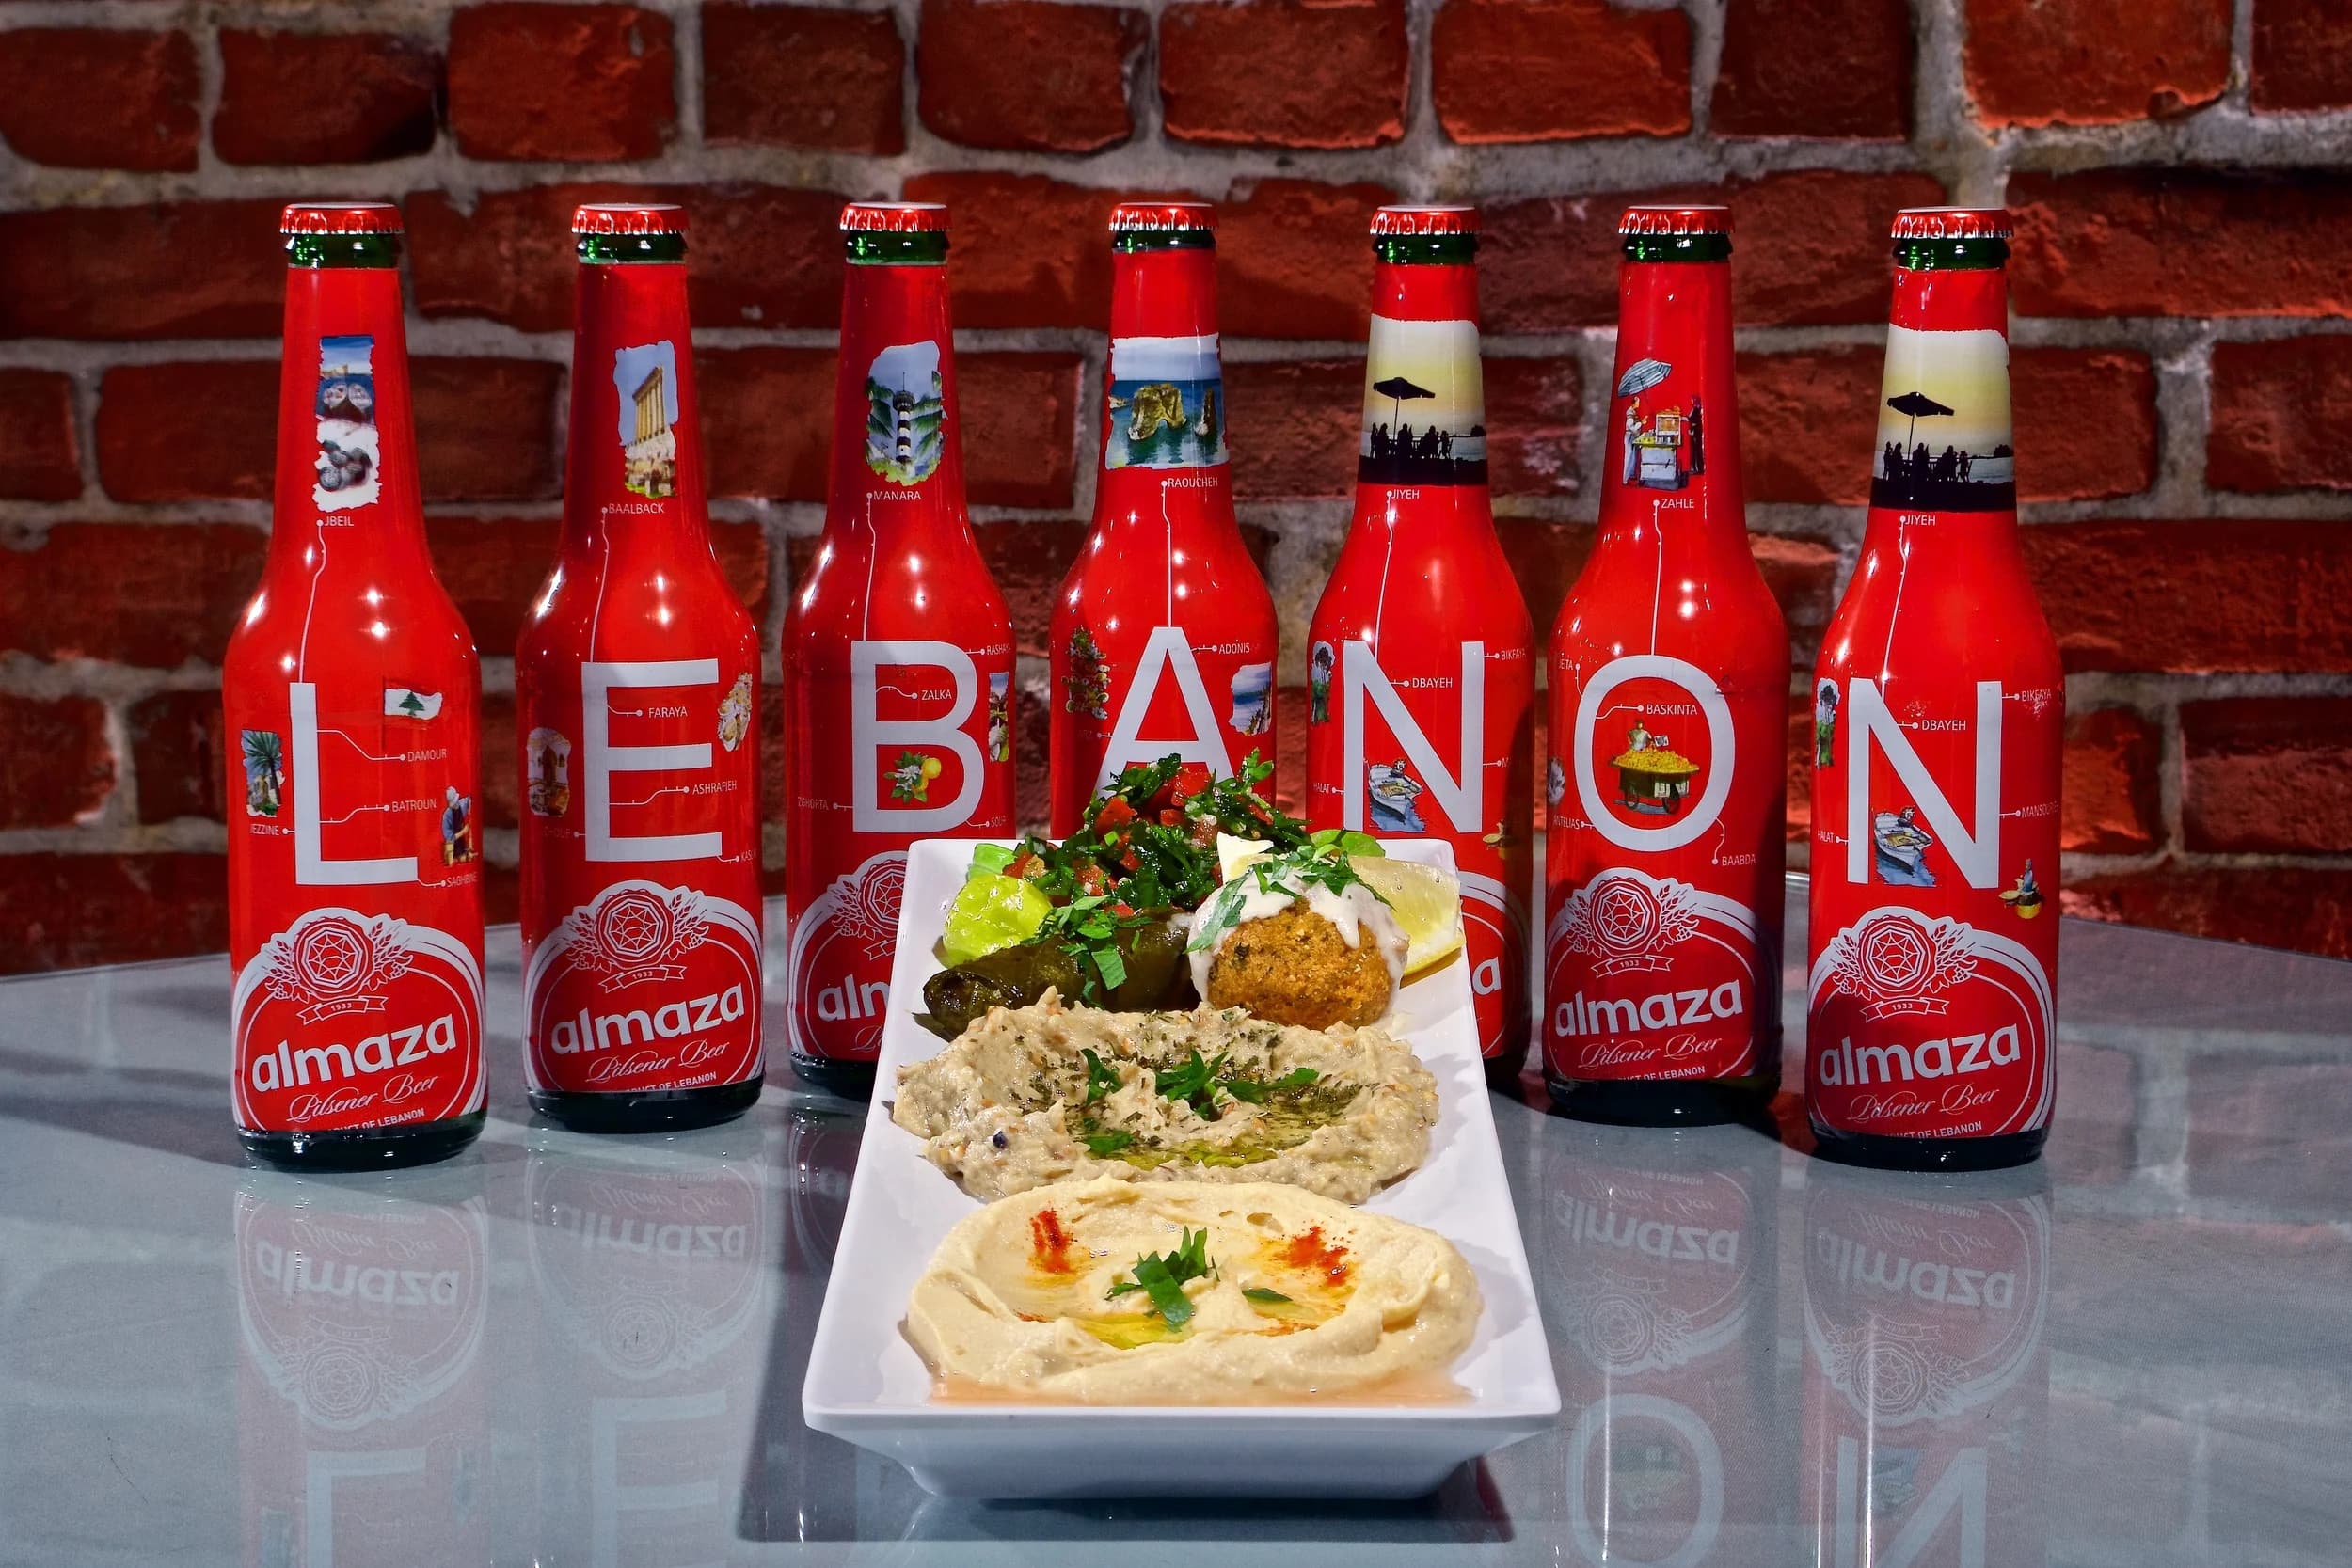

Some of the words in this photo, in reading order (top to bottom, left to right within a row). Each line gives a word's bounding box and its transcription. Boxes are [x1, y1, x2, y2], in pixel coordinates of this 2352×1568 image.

[1168, 477, 1219, 488] RAOUCHEH
[873, 490, 922, 501] MANARA
[1391, 489, 1420, 499] JIYEH
[609, 502, 665, 515] BAALBACK
[1661, 498, 1695, 509] ZAHLE
[324, 515, 355, 528] JBEIL
[1906, 515, 1936, 527] JIYEH
[1219, 641, 1250, 655] ADONIS
[1412, 677, 1454, 689] DBAYEH
[921, 689, 952, 702] ZALKA
[648, 706, 688, 719] FARAYA
[1093, 626, 1237, 800] A
[1646, 703, 1698, 715] BASKINTA
[1922, 720, 1966, 731] DBAYEH
[850, 640, 985, 832] B
[1343, 640, 1485, 832] N
[407, 748, 447, 762] DAMOUR
[581, 658, 723, 862] E
[1574, 655, 1736, 852] O
[290, 682, 419, 884] L
[692, 781, 738, 795] ASHRAFIEH
[1847, 677, 2002, 889] N
[391, 799, 437, 813] BATROUN
[1722, 852, 1756, 867] BAABDA
[1620, 959, 1640, 969] 1933
[632, 970, 654, 980] 1933
[330, 1002, 353, 1012] 1933
[1555, 979, 1743, 1037] almaza
[1892, 1003, 1913, 1011] 1933
[551, 983, 745, 1054] almaza
[252, 1014, 456, 1092] almaza
[1578, 1039, 1661, 1069] Pilsener
[1663, 1034, 1723, 1061] Beer
[1820, 1023, 2021, 1086] almaza
[585, 1050, 675, 1083] Pilsener
[678, 1038, 730, 1068] Beer
[674, 1071, 717, 1088] LEBANON
[1658, 1065, 1706, 1081] LEBANON
[286, 1086, 378, 1124] Pilsener
[382, 1073, 439, 1104] Beer
[1846, 1090, 1936, 1124] Pilsener
[1939, 1083, 2000, 1116] Beer
[377, 1107, 425, 1127] LEBANON
[1933, 1120, 1983, 1138] LEBANON
